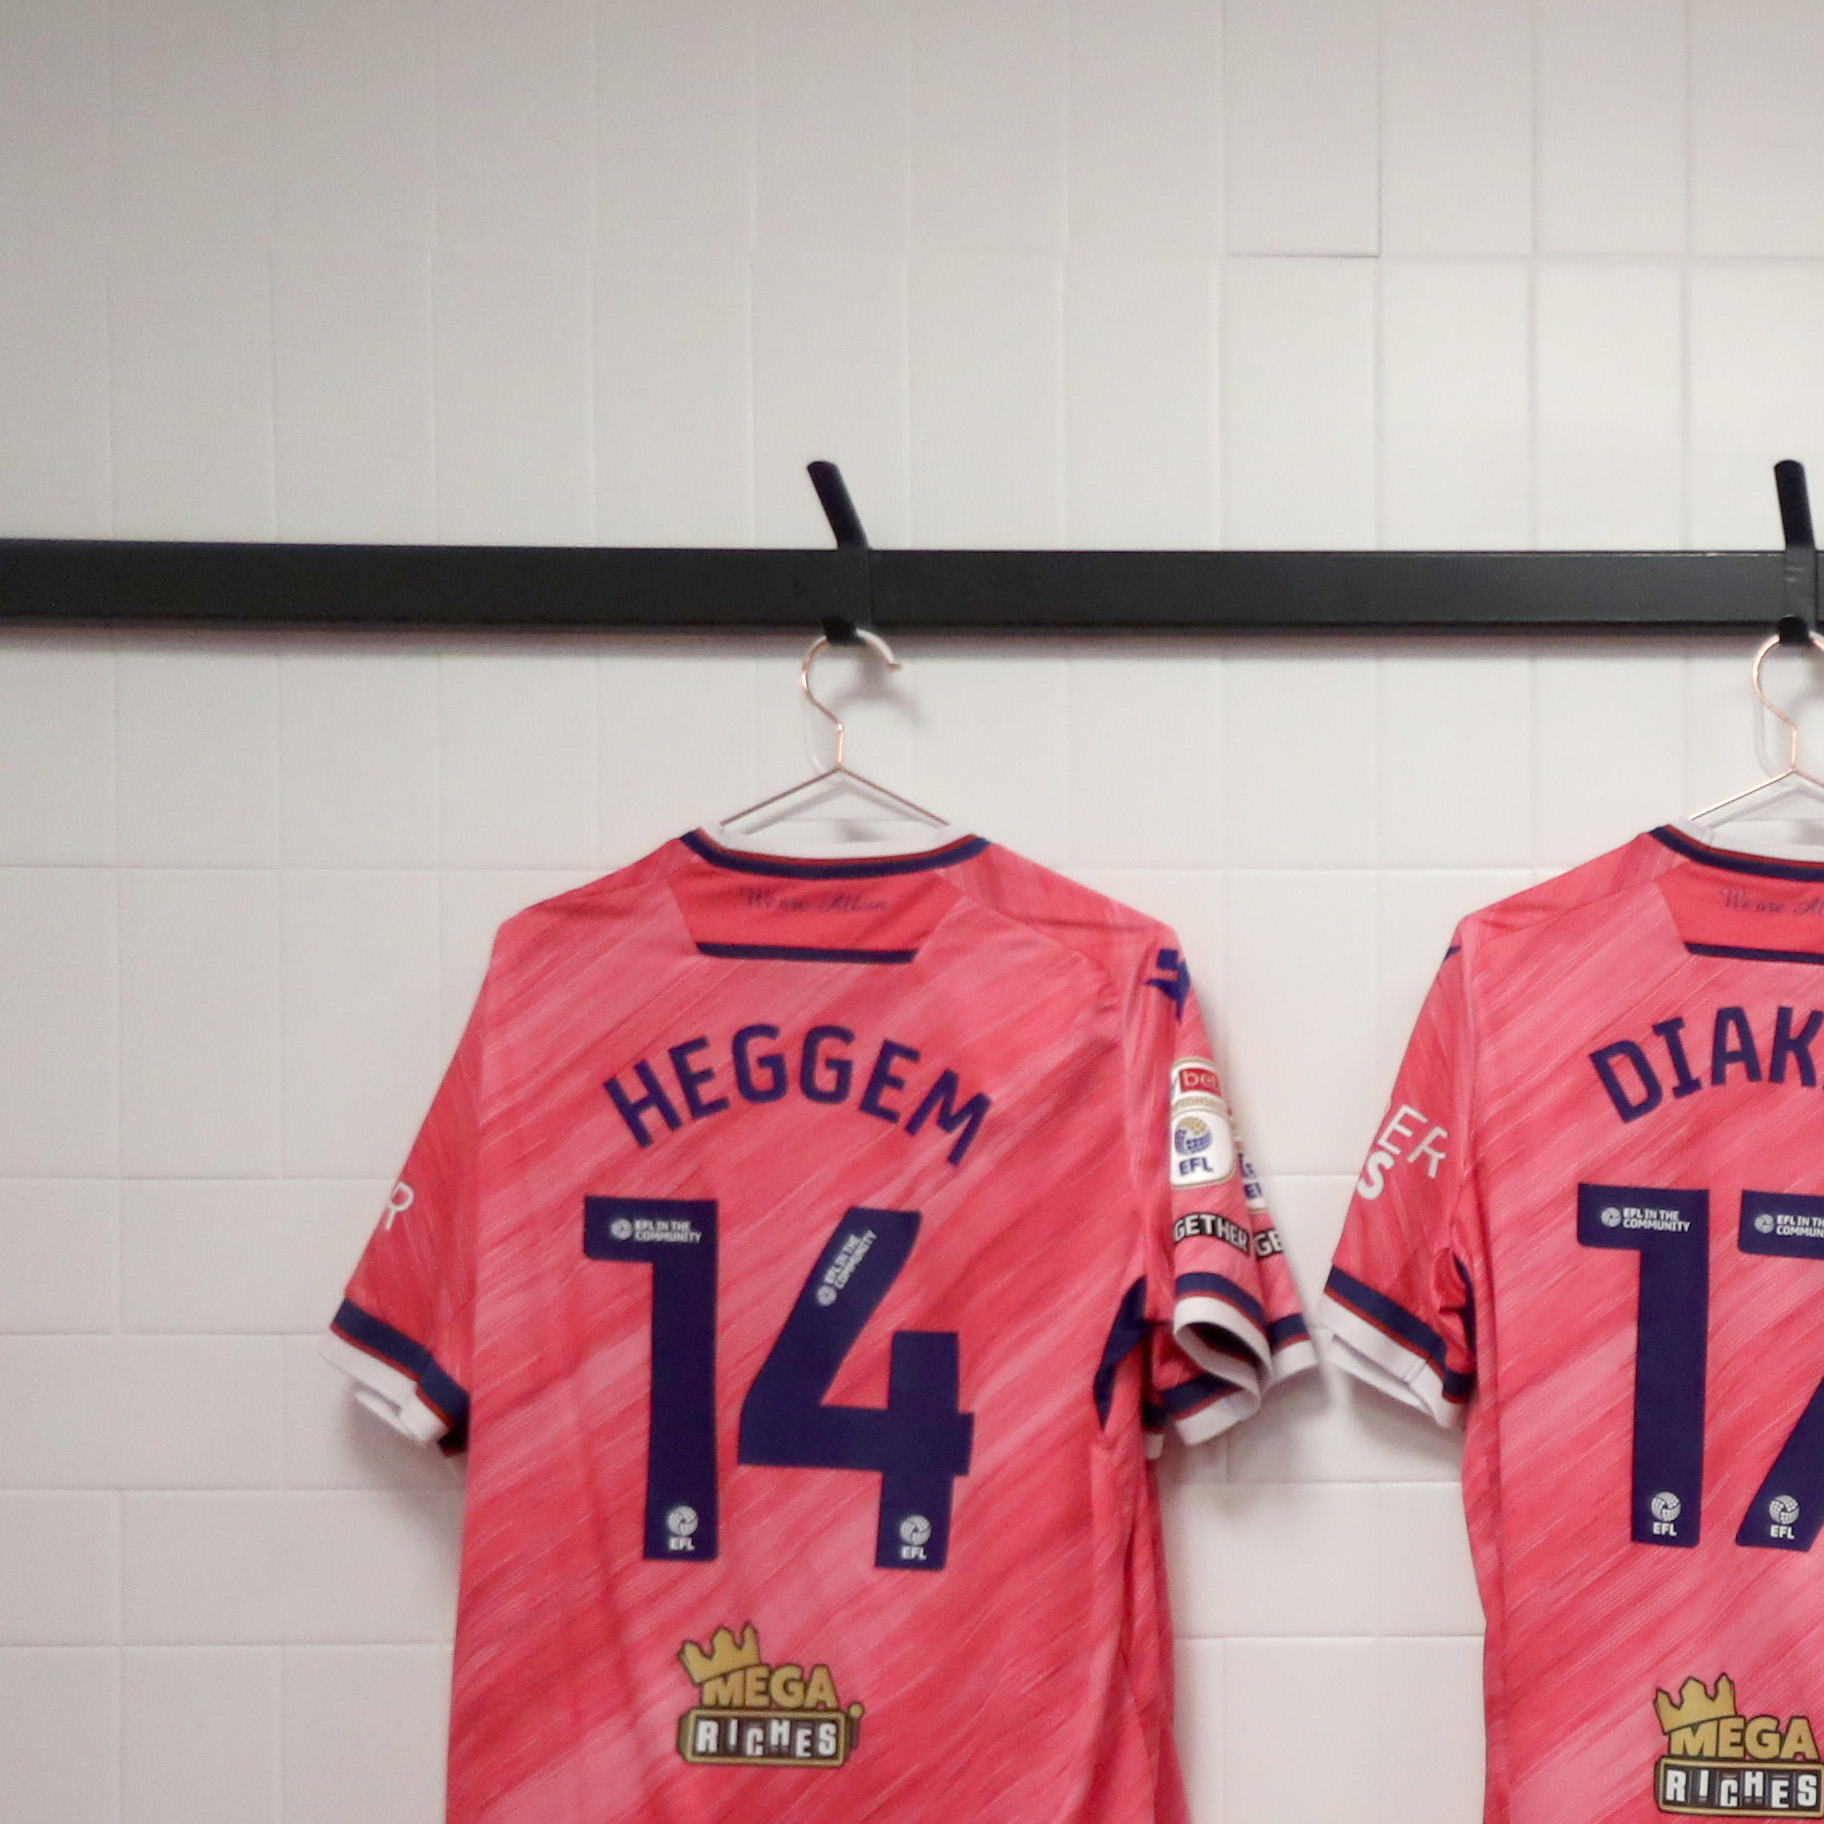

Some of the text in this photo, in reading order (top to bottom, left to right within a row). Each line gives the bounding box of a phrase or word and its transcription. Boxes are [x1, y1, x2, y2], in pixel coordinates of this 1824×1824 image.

[604, 1024, 991, 1165] HEGGEM
[1179, 1157, 1214, 1177] EFL
[1623, 1207, 1680, 1221] EFL IN THE
[1777, 1214, 1795, 1226] EFL
[1797, 1215, 1809, 1227] IN
[1623, 1218, 1691, 1232] COMMUNITY
[582, 1195, 974, 1572] 14
[1652, 1522, 1678, 1537] EFL
[1769, 1524, 1795, 1540] EFL
[667, 1536, 695, 1552] EFL
[901, 1545, 927, 1561] EFL
[701, 1663, 839, 1709] MEGA
[695, 1718, 838, 1758] RICHES
[1668, 1715, 1821, 1761] MEGA
[1666, 1769, 1818, 1809] RICHES
